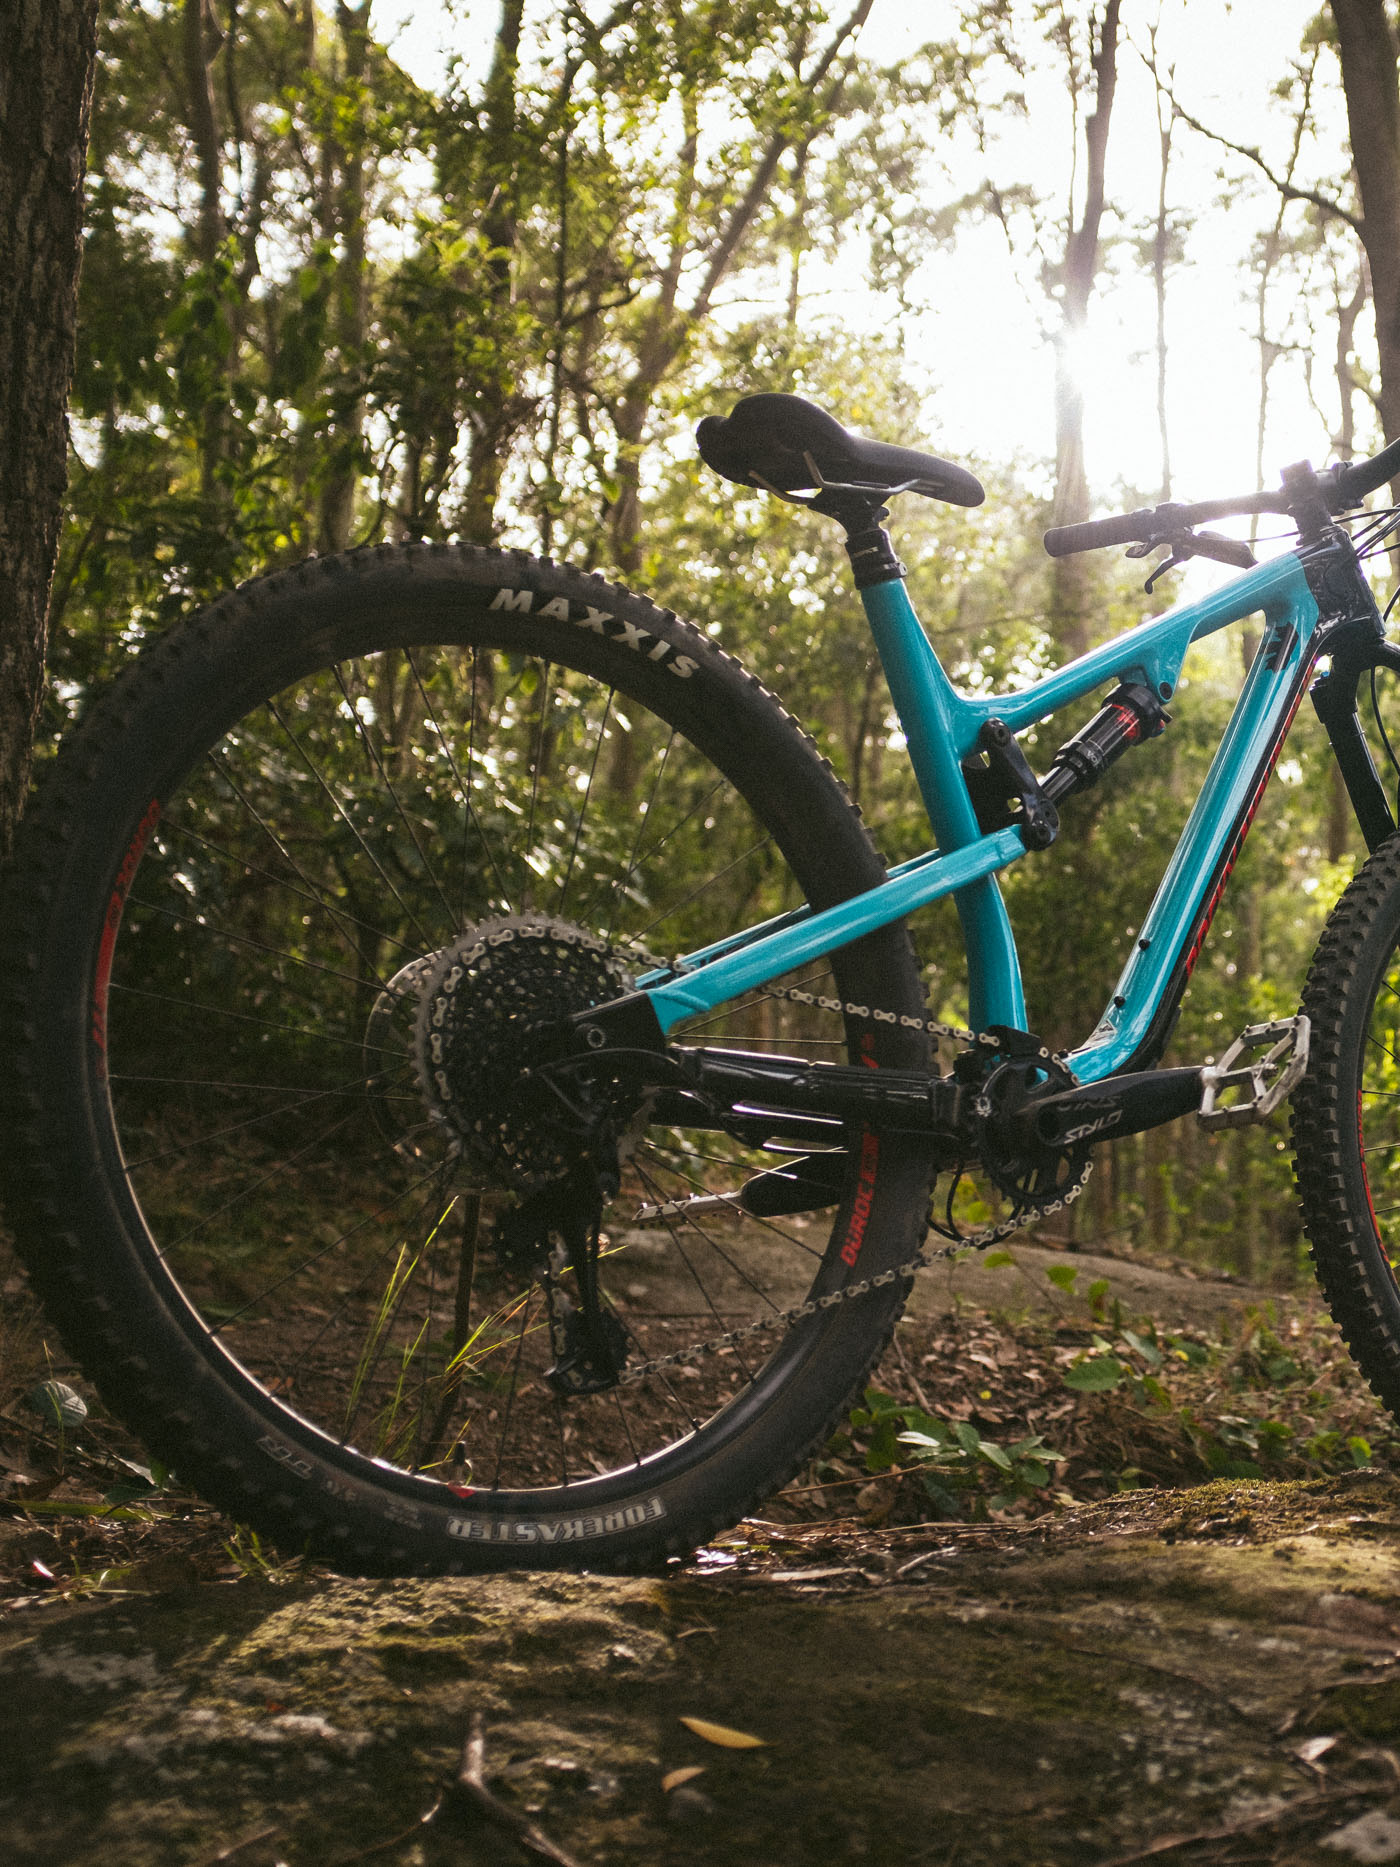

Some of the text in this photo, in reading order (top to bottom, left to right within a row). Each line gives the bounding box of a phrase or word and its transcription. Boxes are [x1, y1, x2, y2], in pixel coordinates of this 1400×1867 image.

[488, 588, 700, 678] MAXXIS
[1063, 1109, 1123, 1144] STYLO
[446, 1495, 667, 1545] FOREKASTER
